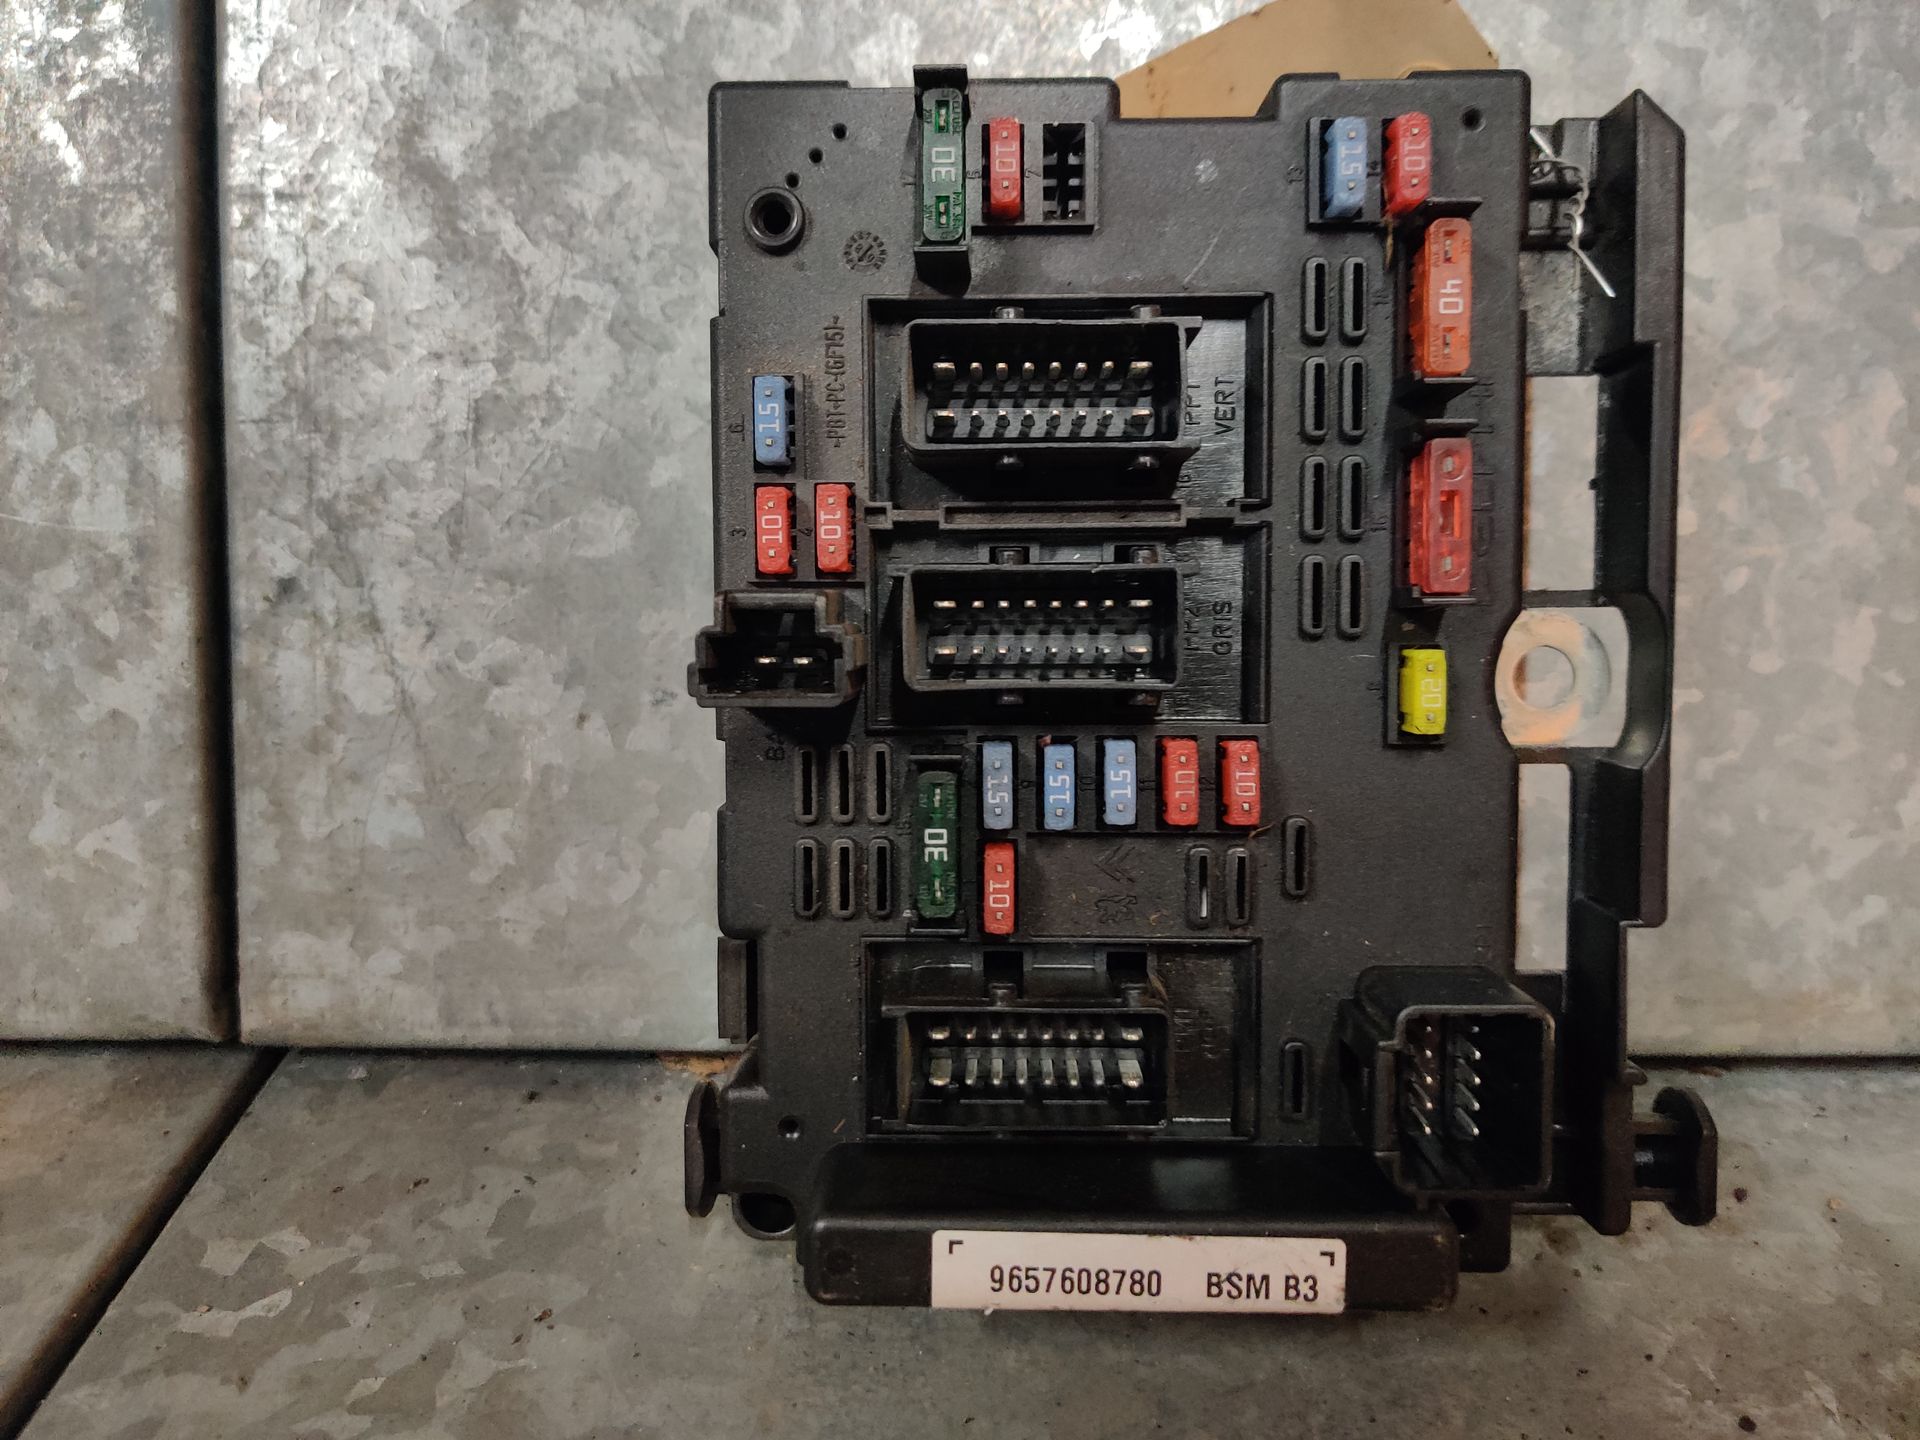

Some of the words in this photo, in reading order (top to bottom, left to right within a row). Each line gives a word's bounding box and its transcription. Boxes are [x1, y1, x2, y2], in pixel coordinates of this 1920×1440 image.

[931, 147, 956, 183] 30
[994, 142, 1016, 173] 10
[1340, 143, 1363, 176] 15
[1403, 138, 1426, 171] 10
[1438, 279, 1464, 315] 40
[758, 402, 780, 433] 15
[1213, 376, 1237, 436] VERT
[761, 514, 784, 544] 10
[819, 511, 843, 540] 10
[1212, 600, 1234, 656] GRIS
[1421, 678, 1443, 708] 20
[986, 774, 1009, 805] 15
[1049, 774, 1071, 804] 15
[1109, 769, 1132, 800] 15
[1174, 770, 1197, 798] 10
[1235, 767, 1257, 796] 10
[924, 828, 948, 863] 30
[989, 880, 1011, 908] 10
[989, 1265, 1162, 1297] 9657608780
[1207, 1271, 1271, 1301] BSM
[1284, 1274, 1319, 1302] B3
